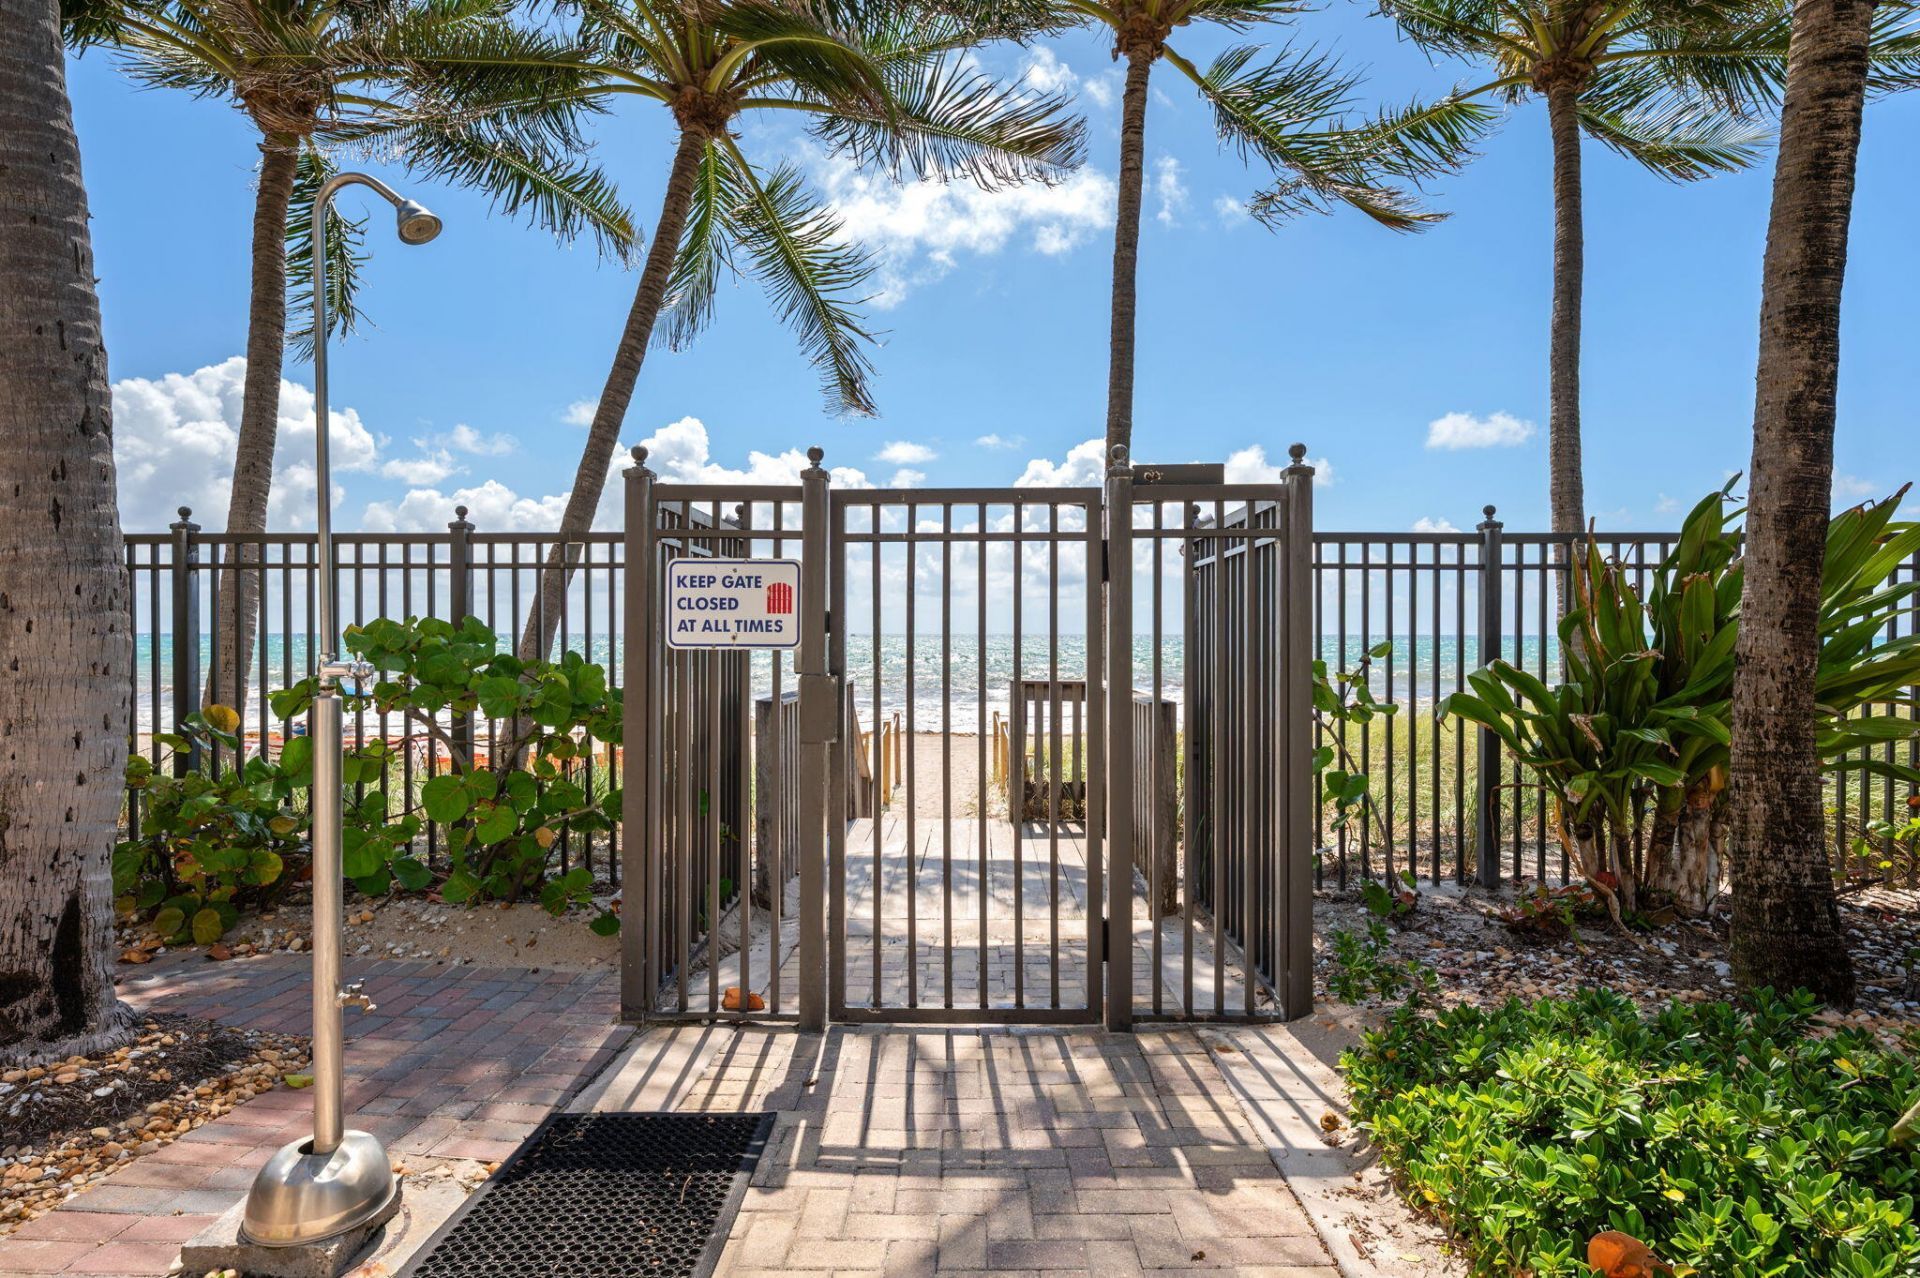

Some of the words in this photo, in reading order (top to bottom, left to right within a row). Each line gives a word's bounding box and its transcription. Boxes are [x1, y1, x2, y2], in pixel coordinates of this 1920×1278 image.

[677, 575, 716, 588] KEEP
[721, 575, 762, 588] GATE
[676, 597, 739, 610] CLOSED
[677, 619, 697, 632] AT
[701, 619, 731, 632] ALL
[735, 619, 783, 632] TIMES
